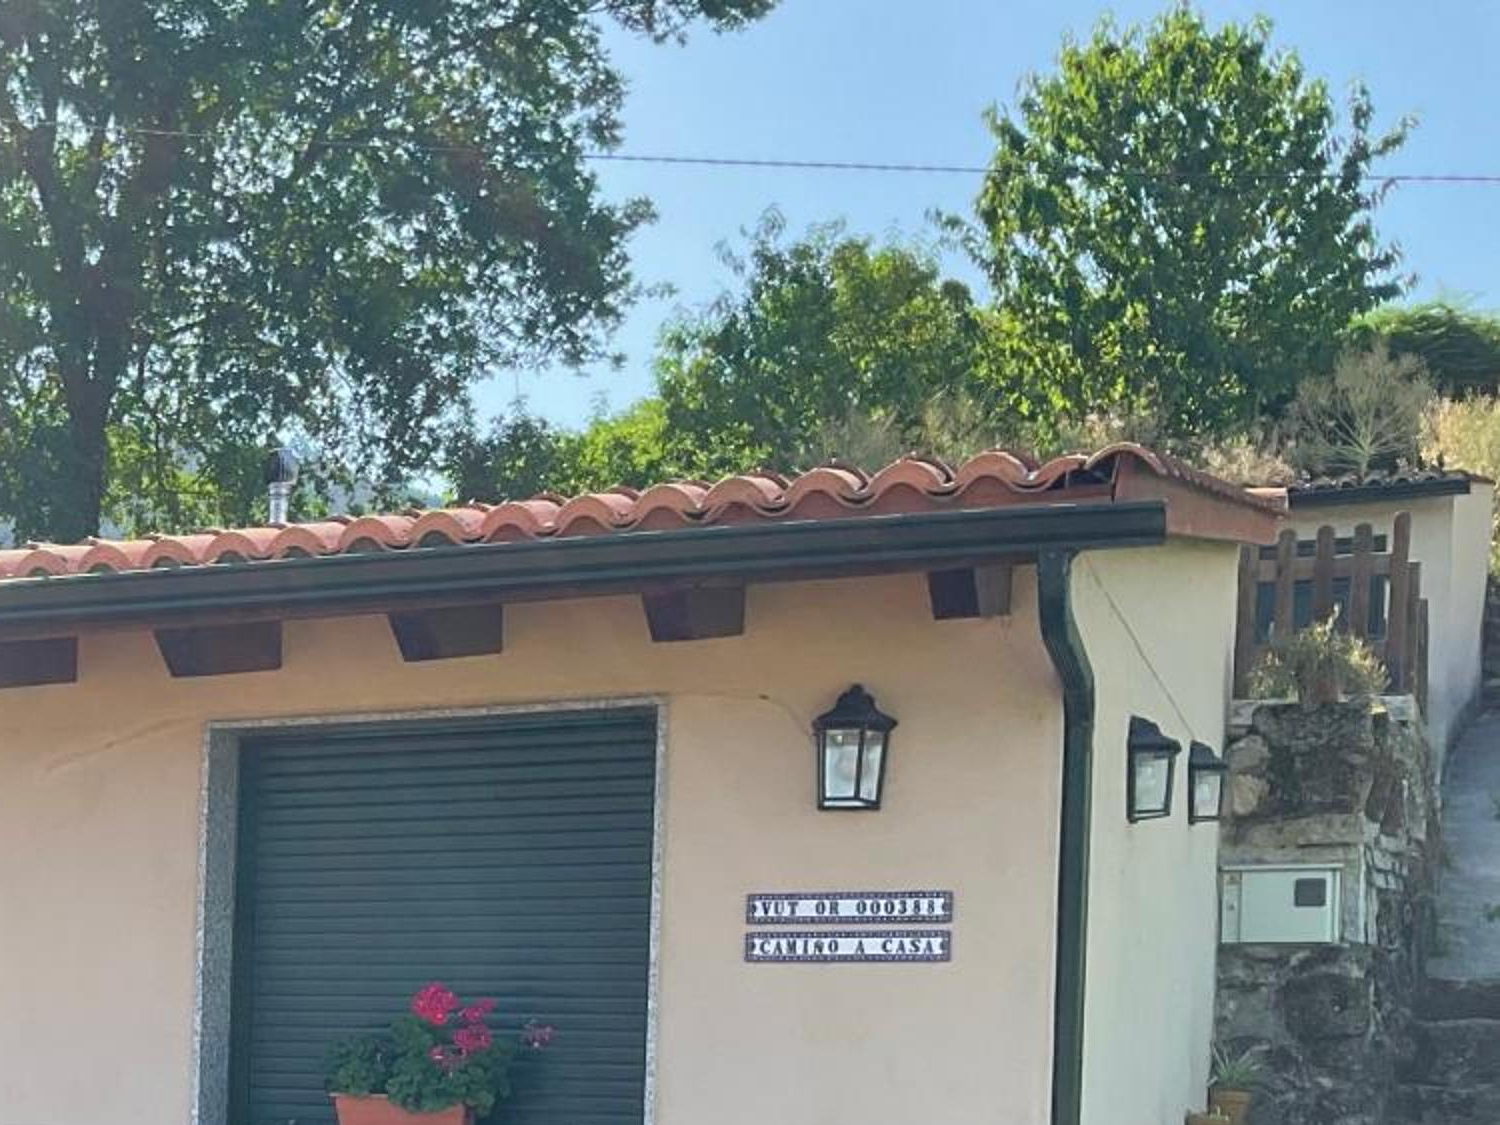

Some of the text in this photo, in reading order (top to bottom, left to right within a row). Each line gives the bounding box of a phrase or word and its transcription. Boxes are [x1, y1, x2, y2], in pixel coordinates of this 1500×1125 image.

[761, 901, 799, 916] VUT
[855, 939, 865, 955] A
[882, 939, 934, 954] CASA
